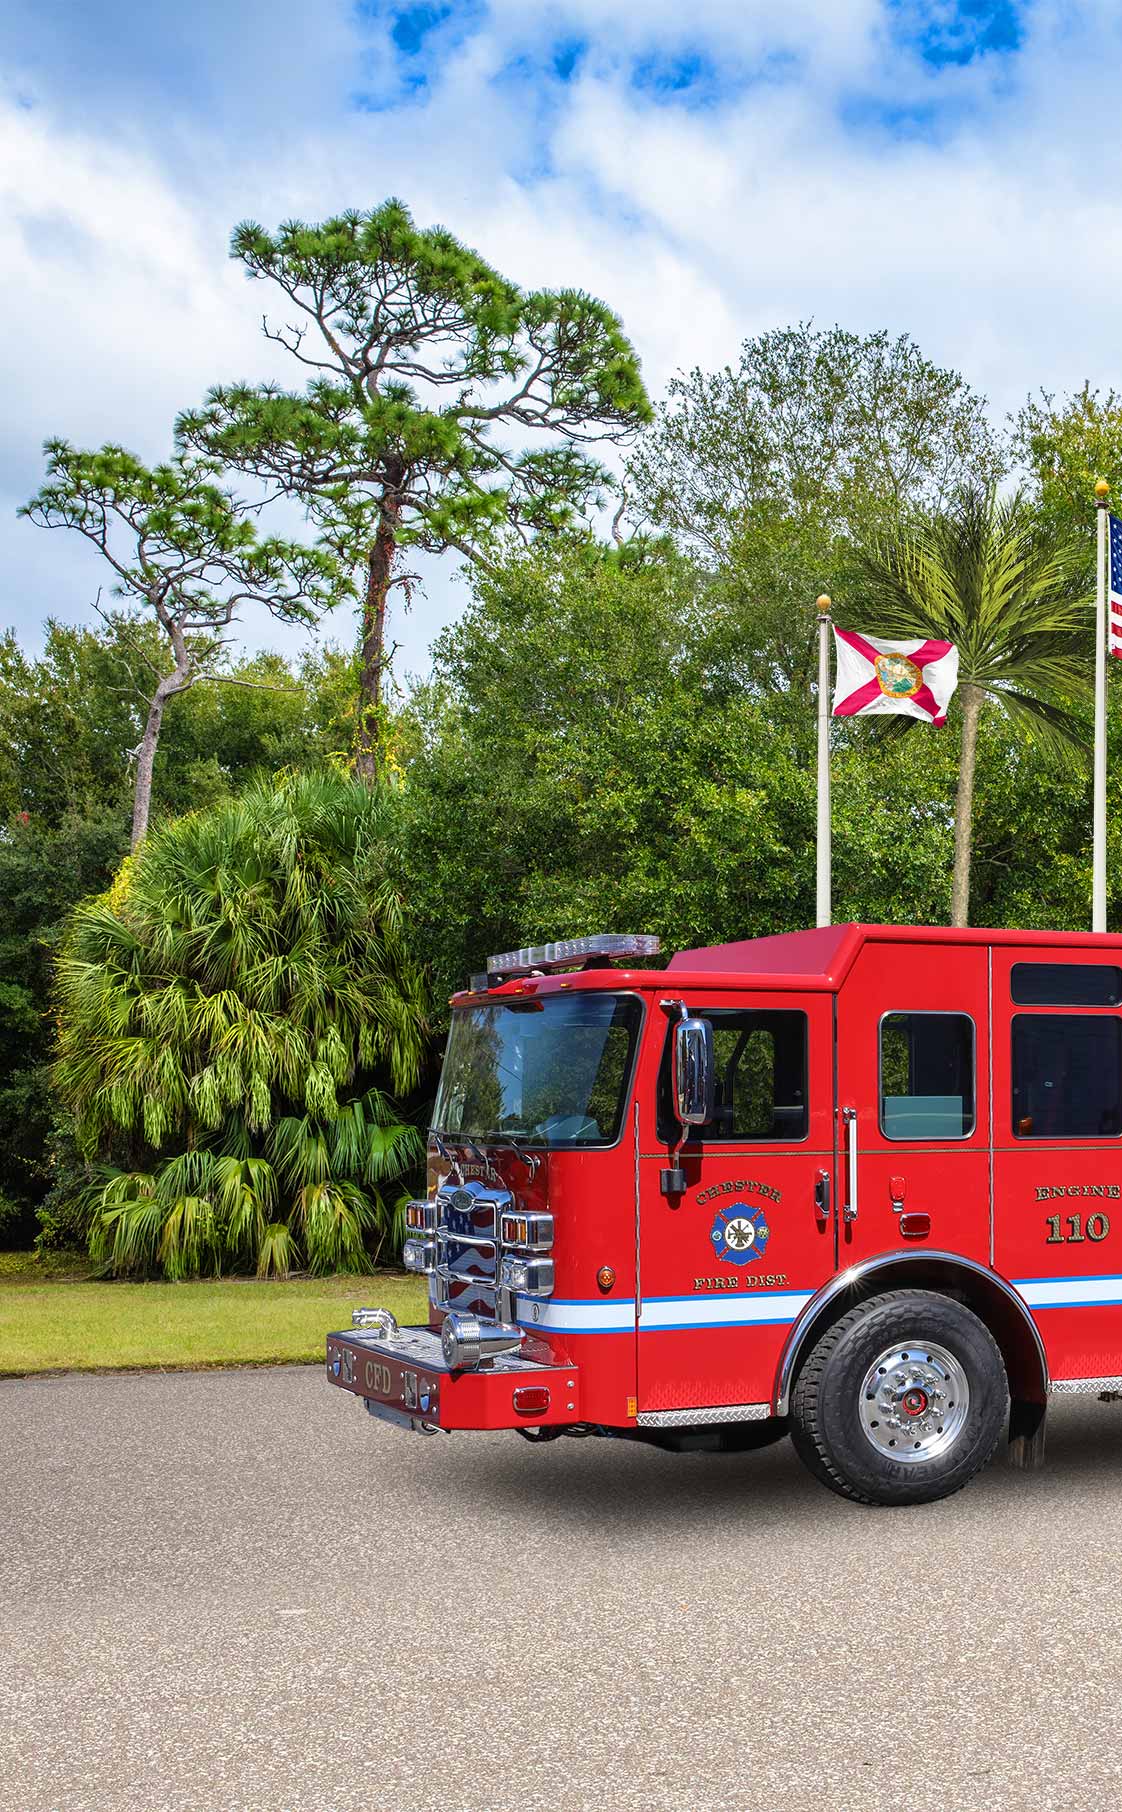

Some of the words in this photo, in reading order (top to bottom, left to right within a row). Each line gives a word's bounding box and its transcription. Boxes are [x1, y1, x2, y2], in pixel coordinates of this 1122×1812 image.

[460, 1163, 497, 1182] CHESTR
[695, 1179, 783, 1206] CHESTER
[1035, 1184, 1121, 1202] ENGINE
[1045, 1212, 1111, 1244] 110
[693, 1276, 739, 1291] FIRE
[745, 1273, 790, 1288] DIST.
[364, 1360, 392, 1395] CFD
